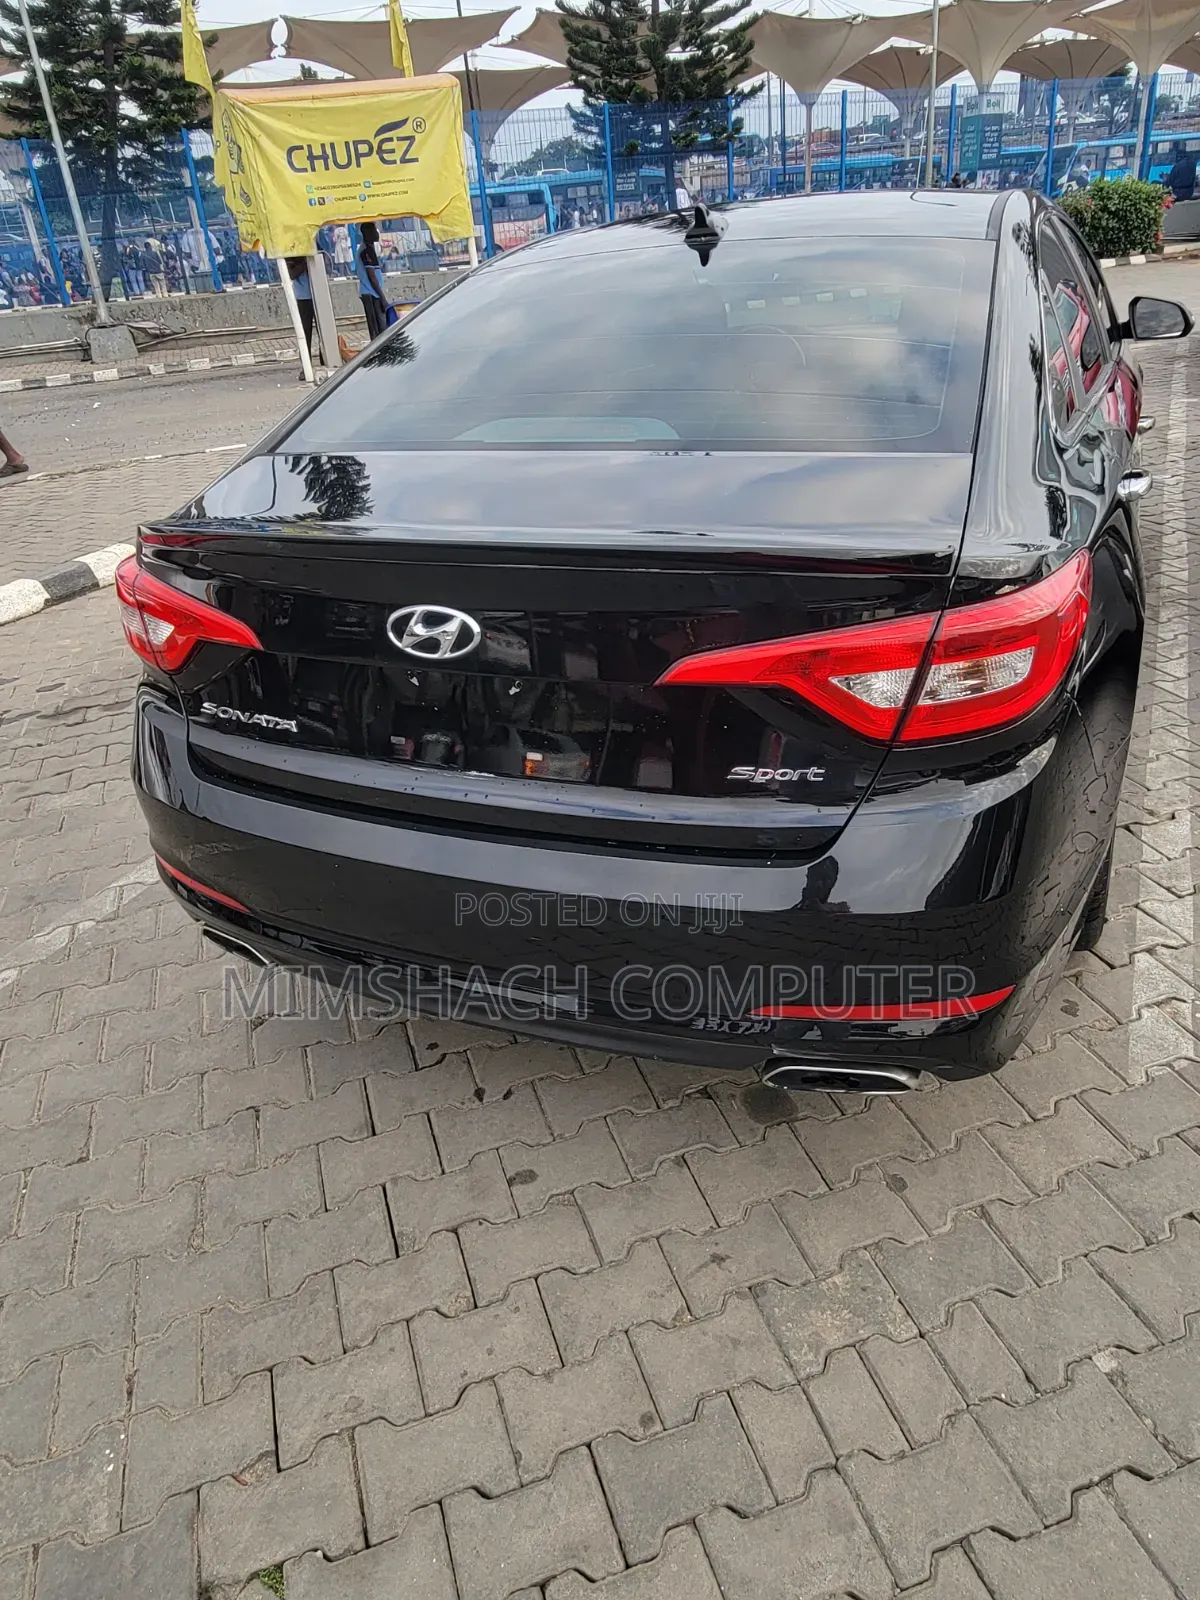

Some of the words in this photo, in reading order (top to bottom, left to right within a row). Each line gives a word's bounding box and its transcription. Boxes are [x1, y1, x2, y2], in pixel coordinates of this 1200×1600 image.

[286, 135, 419, 173] CHUPEZ
[200, 702, 298, 732] SONATA
[725, 766, 826, 783] Sport
